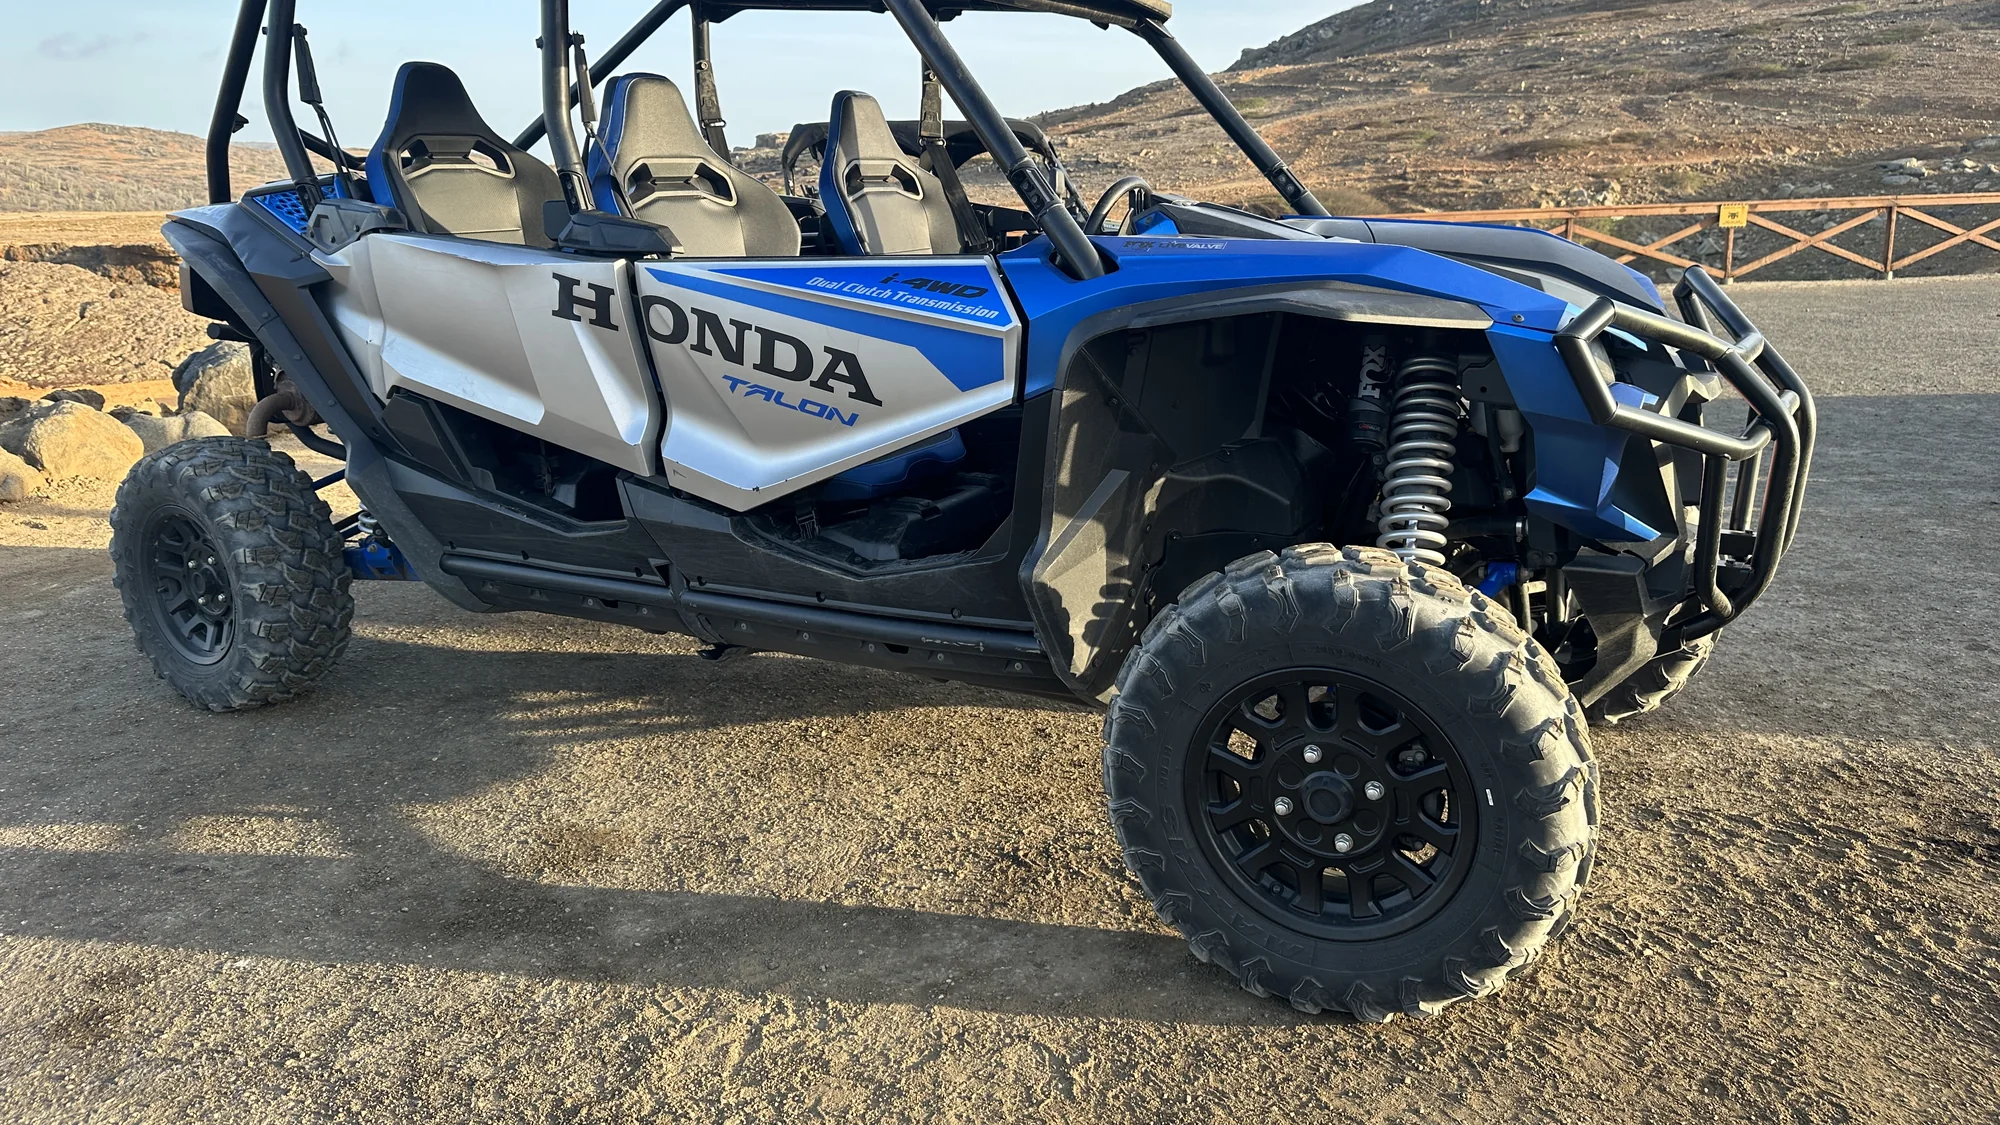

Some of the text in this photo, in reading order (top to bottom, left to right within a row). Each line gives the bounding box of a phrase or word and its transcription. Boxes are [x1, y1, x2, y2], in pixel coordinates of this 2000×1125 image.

[805, 276, 1000, 320] Dual Clutch Transmission
[879, 272, 988, 299] i-4WD
[551, 272, 882, 407] HONDA
[1358, 345, 1387, 399] FOX
[722, 374, 860, 427] TALON
